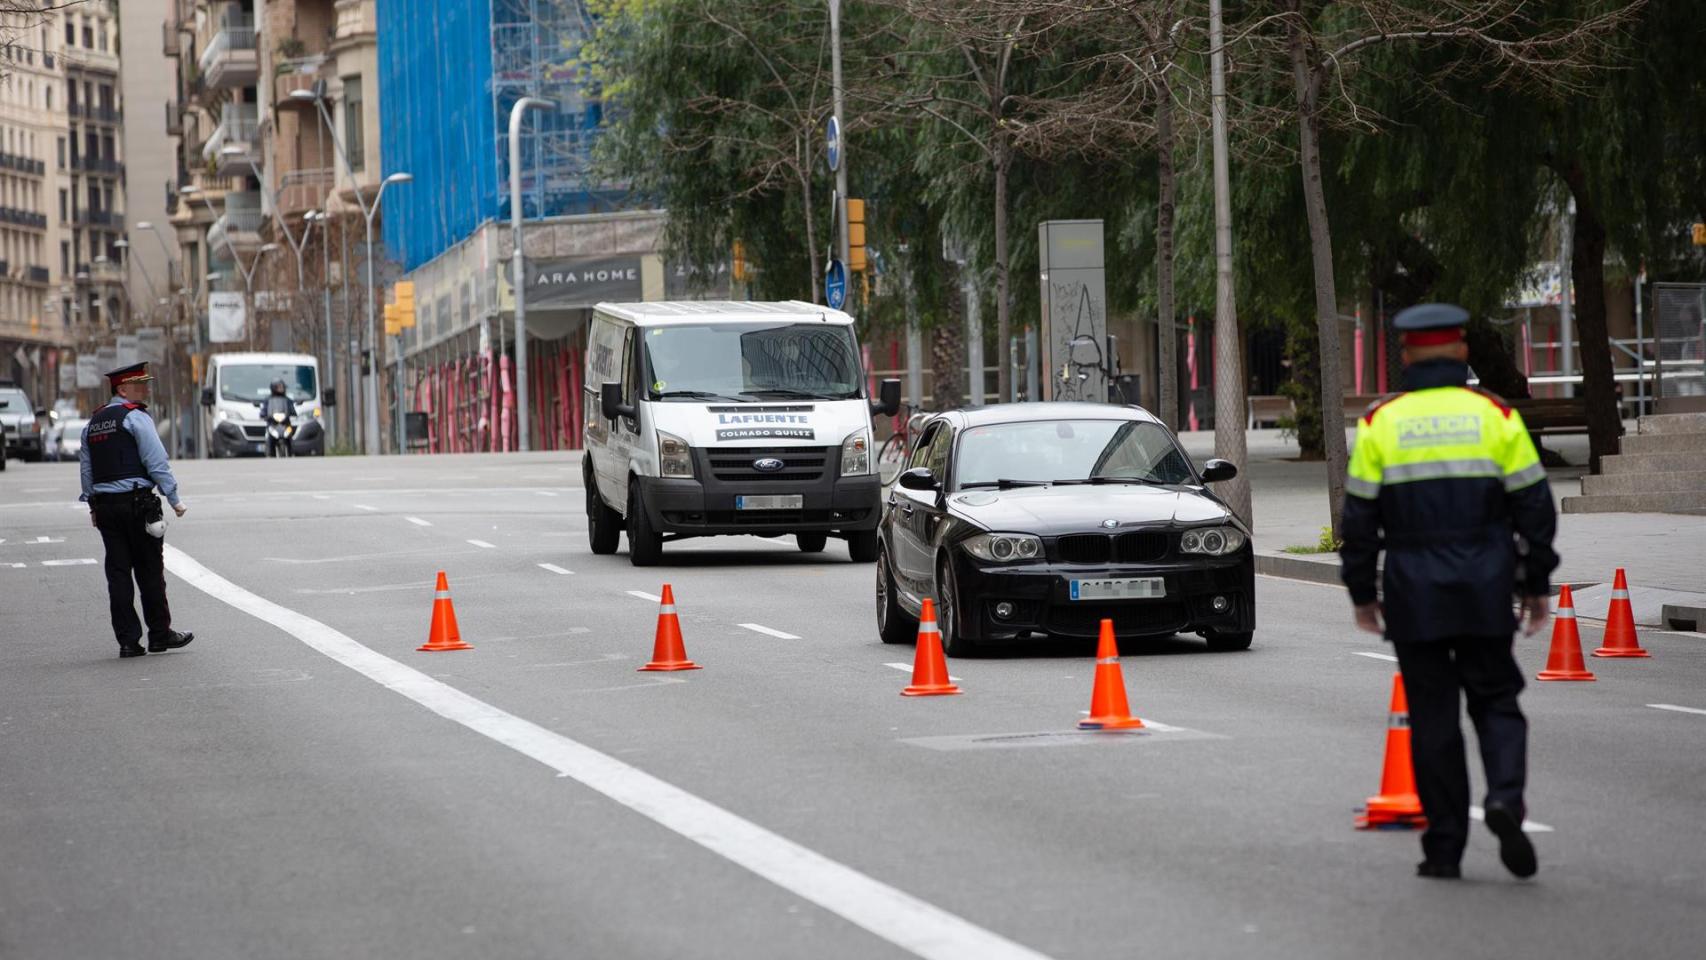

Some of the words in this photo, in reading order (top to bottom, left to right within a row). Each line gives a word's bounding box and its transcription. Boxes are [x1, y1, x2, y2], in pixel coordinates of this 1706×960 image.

[584, 269, 637, 282] HOME
[718, 413, 808, 425] LAFUENTE
[89, 419, 117, 433] POLICIA
[1399, 415, 1480, 437] POLICIA
[720, 429, 770, 438] COLMADO
[774, 429, 810, 437] QUILEZ
